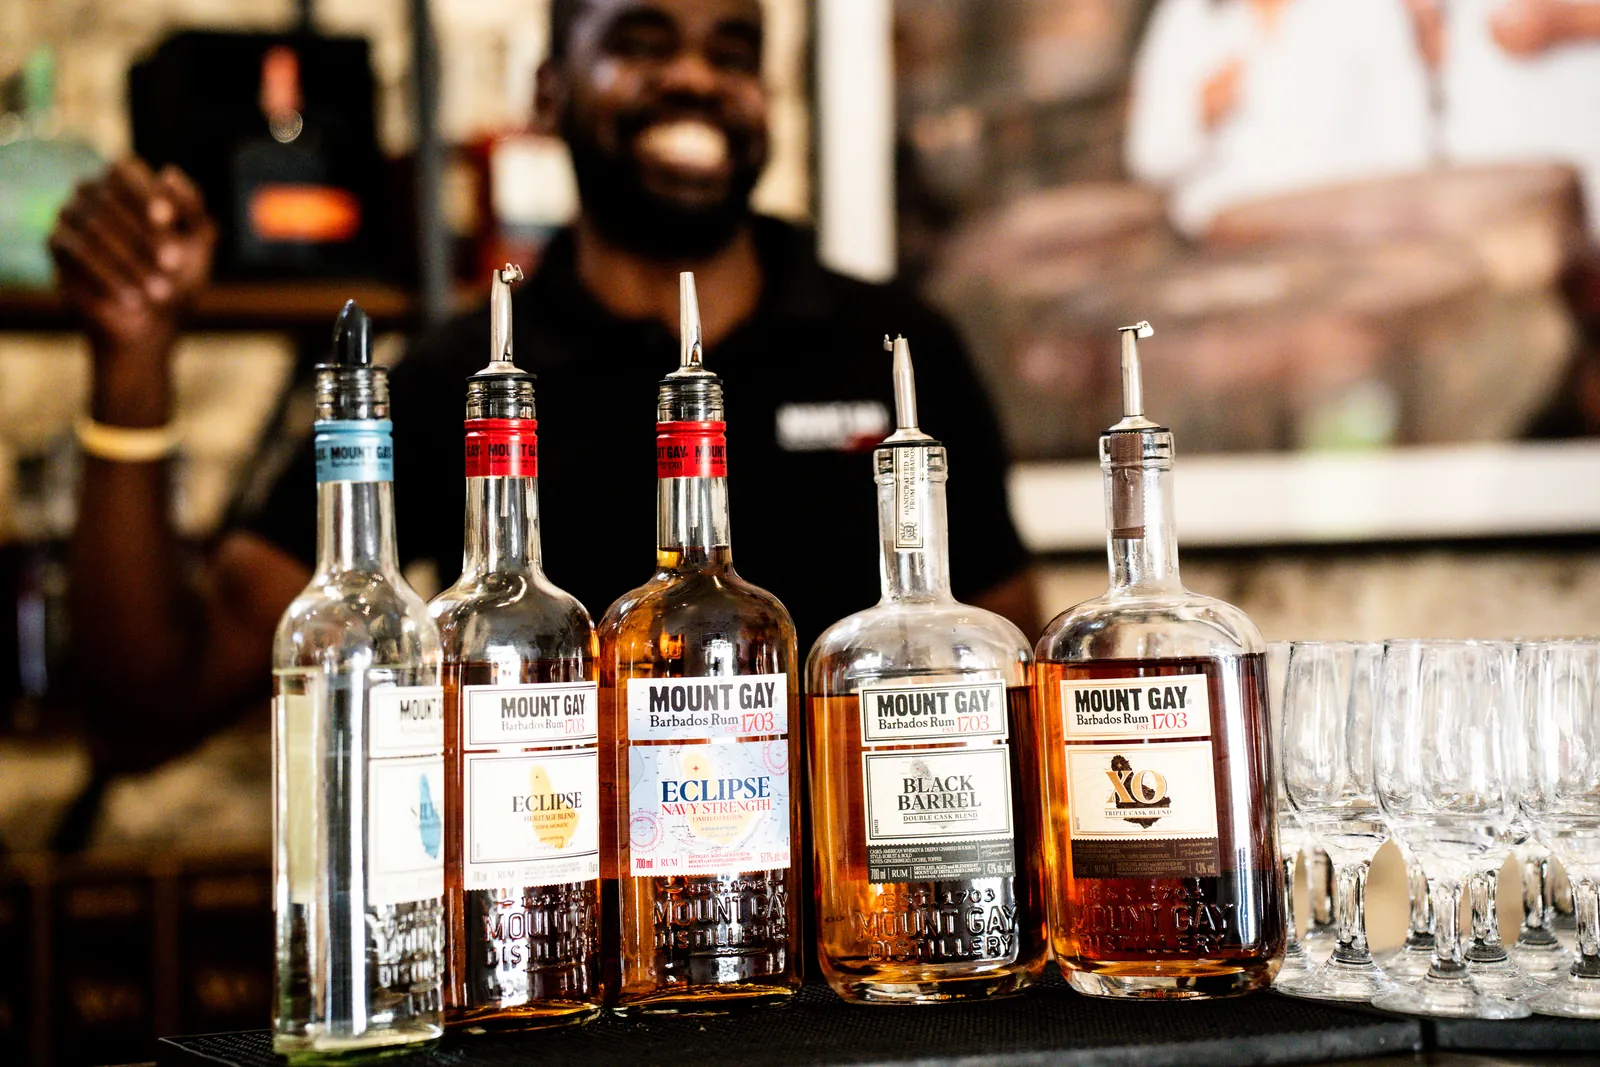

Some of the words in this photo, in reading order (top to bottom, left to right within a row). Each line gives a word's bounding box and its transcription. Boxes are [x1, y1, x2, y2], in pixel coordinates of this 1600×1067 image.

[667, 446, 686, 458] GAY
[501, 695, 560, 718] MOUNT
[564, 693, 585, 716] GAY
[649, 684, 733, 712] MOUNT
[739, 682, 775, 709] GAY
[877, 692, 949, 717] MOUNT
[954, 689, 990, 714] GAY
[1075, 688, 1142, 712] MOUNT
[1148, 686, 1187, 710] GAY
[502, 719, 544, 731] Barbados
[545, 719, 564, 729] Rum
[564, 718, 585, 734] 1703
[650, 714, 708, 728] Barbados
[711, 713, 739, 726] Rum
[741, 711, 774, 733] 1703
[878, 716, 928, 730] Barbados
[930, 717, 955, 728] Rum
[957, 715, 990, 732] 1703
[1077, 714, 1122, 725] Barbados
[1124, 713, 1149, 724] Rum
[1151, 712, 1188, 730] 1703
[661, 776, 770, 803] ECLIPSE
[903, 775, 974, 794] BLACK
[1105, 769, 1167, 804] XO
[512, 791, 582, 812] ECLIPSE
[661, 803, 699, 816] NAVY
[702, 799, 771, 815] STRENGTH
[898, 791, 982, 811] BARREL
[557, 812, 575, 820] BLEND
[903, 814, 933, 822] DOUBLE
[635, 858, 645, 869] 700
[660, 858, 678, 867] RUM
[891, 869, 908, 878] RUM
[943, 888, 996, 905] 1703
[653, 896, 744, 927] MOUNT
[1172, 902, 1234, 931] GAY
[855, 908, 959, 941] MOUNT
[965, 905, 1018, 936] GAY
[868, 935, 1013, 962] DISTILLERY
[1079, 934, 1225, 954] DISTILLERY
